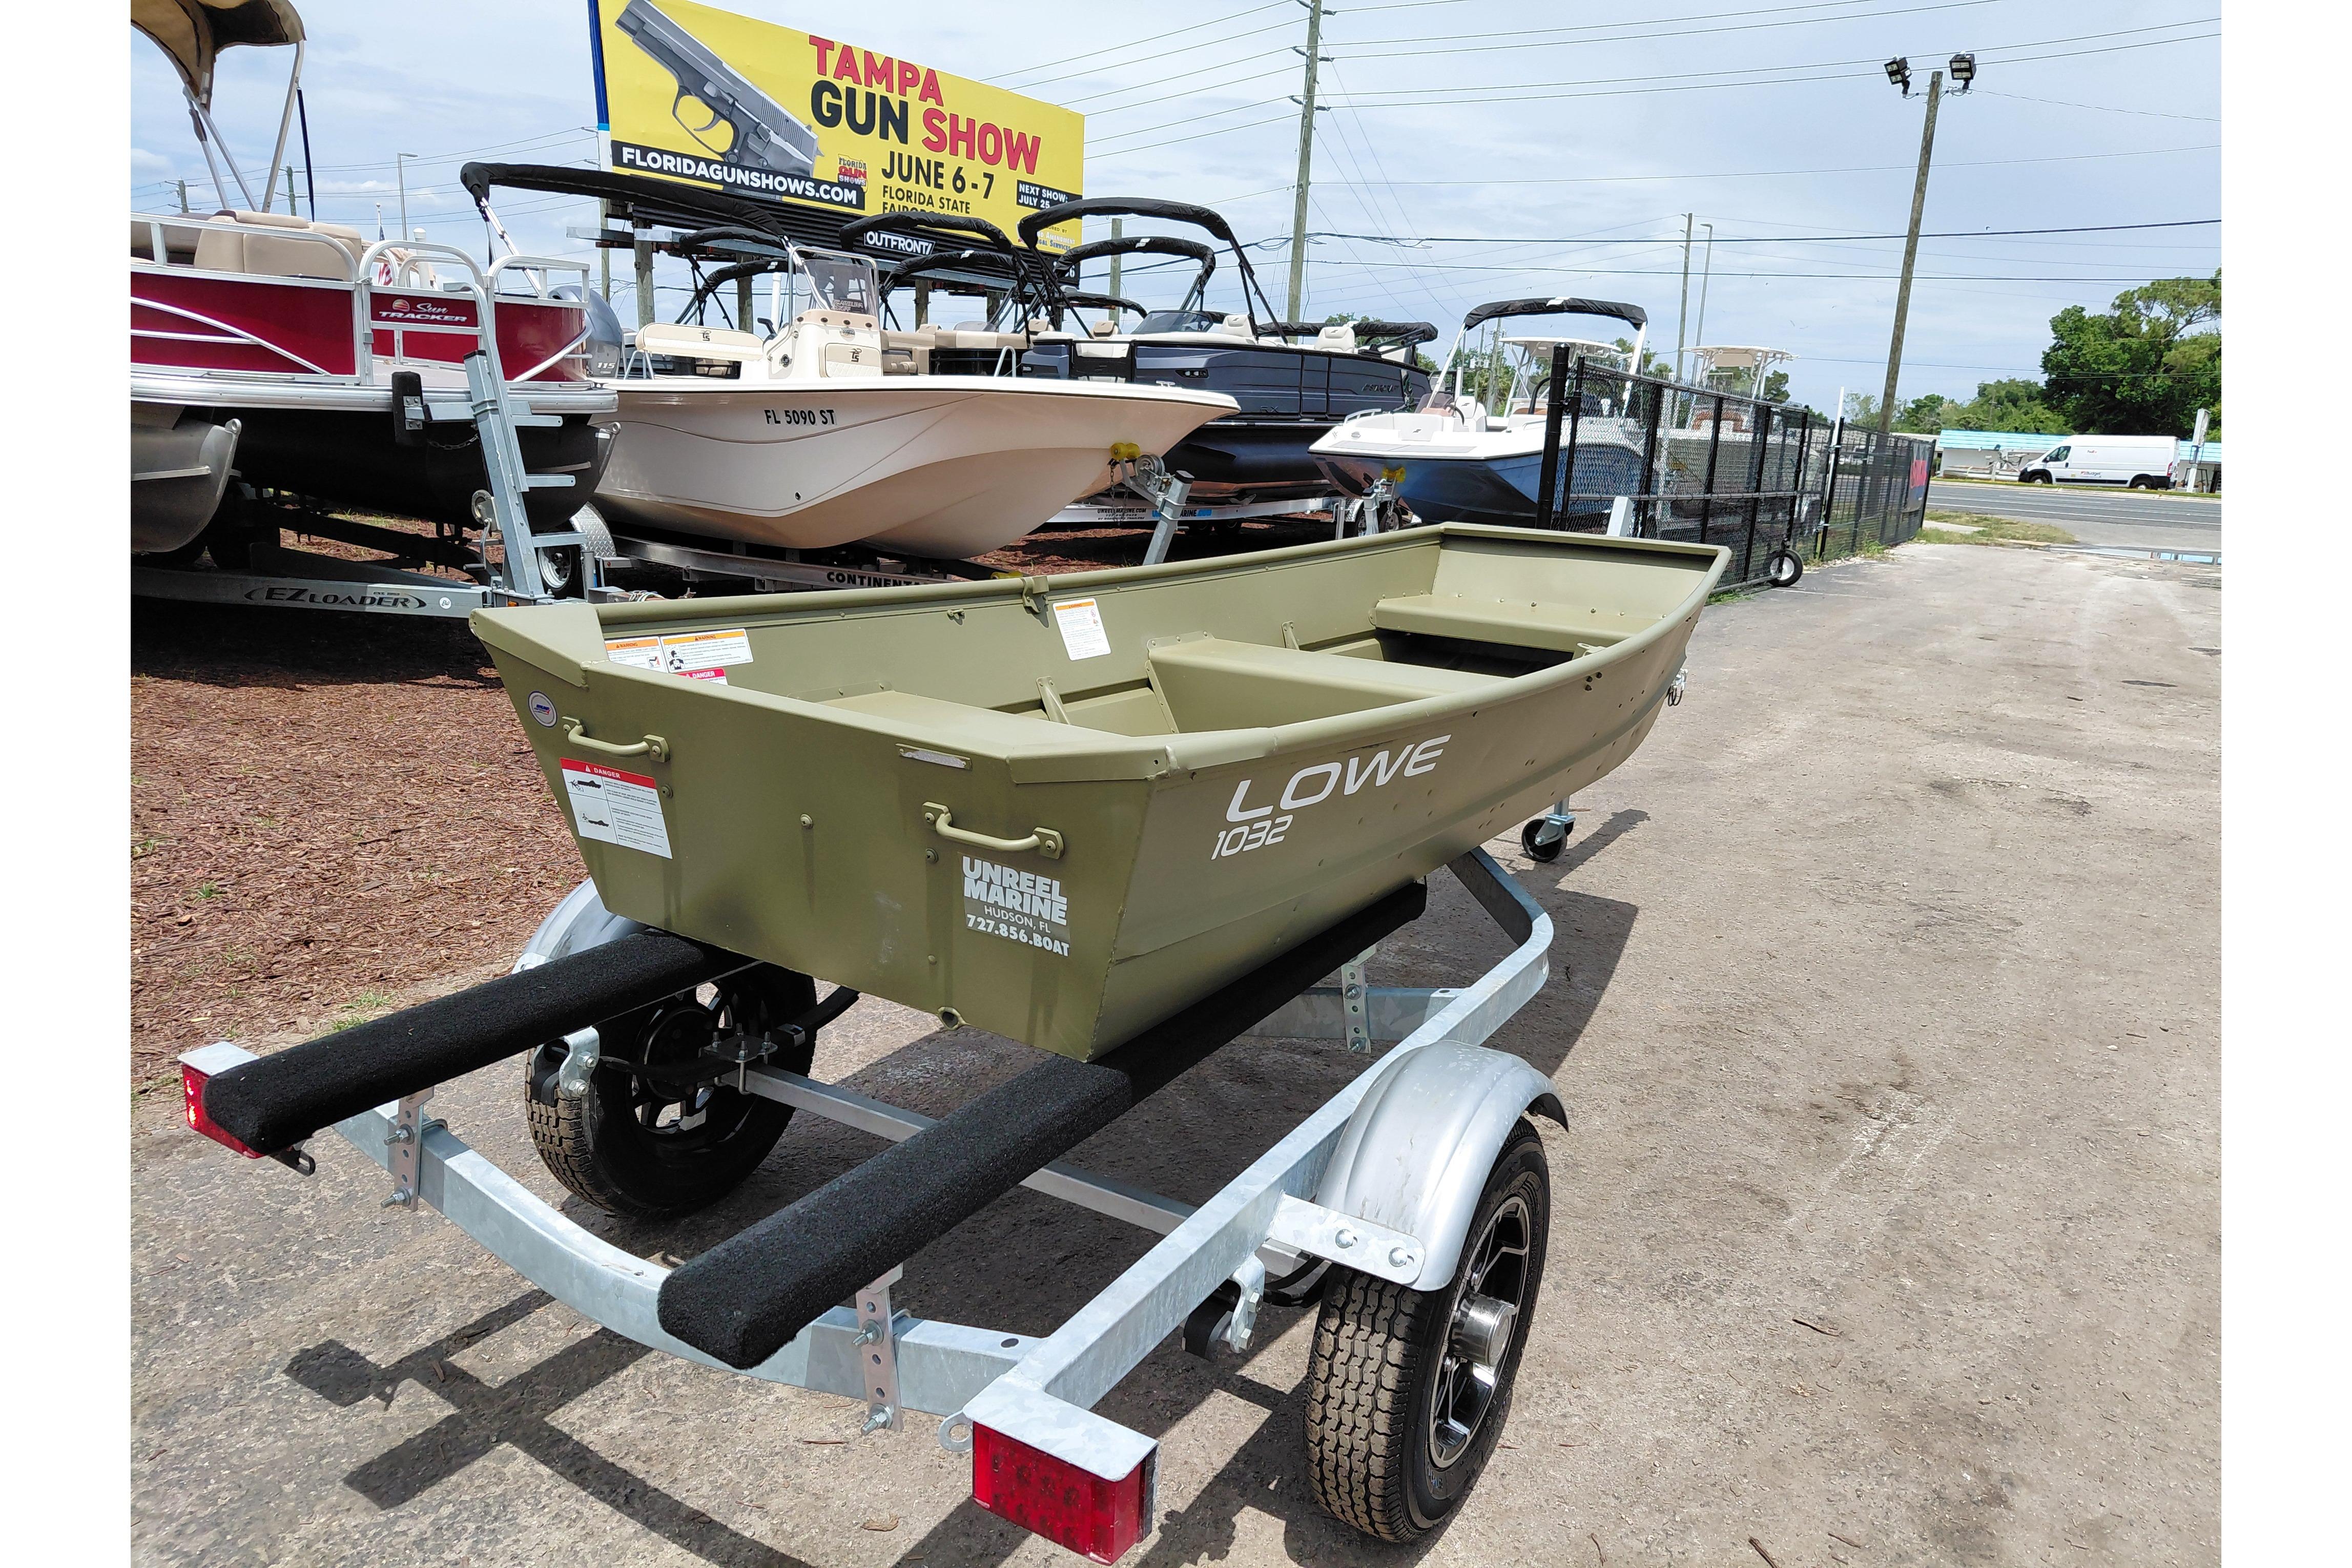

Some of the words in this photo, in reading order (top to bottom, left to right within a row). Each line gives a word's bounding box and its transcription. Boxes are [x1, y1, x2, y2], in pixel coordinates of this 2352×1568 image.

[809, 35, 944, 107] TAMPA
[811, 80, 909, 145] GUN
[922, 108, 1041, 175] SHOW
[622, 147, 857, 205] FLORIDAGUNSHOWS.COM
[838, 156, 867, 170] FLORIDA
[838, 166, 867, 179] GUN
[881, 151, 944, 190] JUNE
[838, 175, 866, 187] SHOWS
[1019, 183, 1040, 196] NEXT
[1042, 189, 1068, 204] SHOW:
[882, 185, 935, 208] FLORIDA
[939, 197, 971, 215] STATE
[1018, 194, 1038, 207] JULY
[1040, 199, 1050, 209] 25
[379, 312, 467, 322] TRACKER
[411, 303, 449, 314] Sun
[764, 409, 781, 424] FL
[784, 410, 816, 425] 5090
[819, 409, 835, 425] ST
[692, 671, 715, 679] DANGER
[593, 767, 621, 779] DANGER
[1226, 734, 1452, 822] LOWE
[1210, 815, 1294, 861] 1032
[962, 856, 1067, 904] UNREEL
[964, 876, 1067, 925] MARINE
[984, 905, 1036, 931] HUDSON,
[1039, 921, 1051, 933] FL
[966, 914, 1069, 957] 727.856.BOAT
